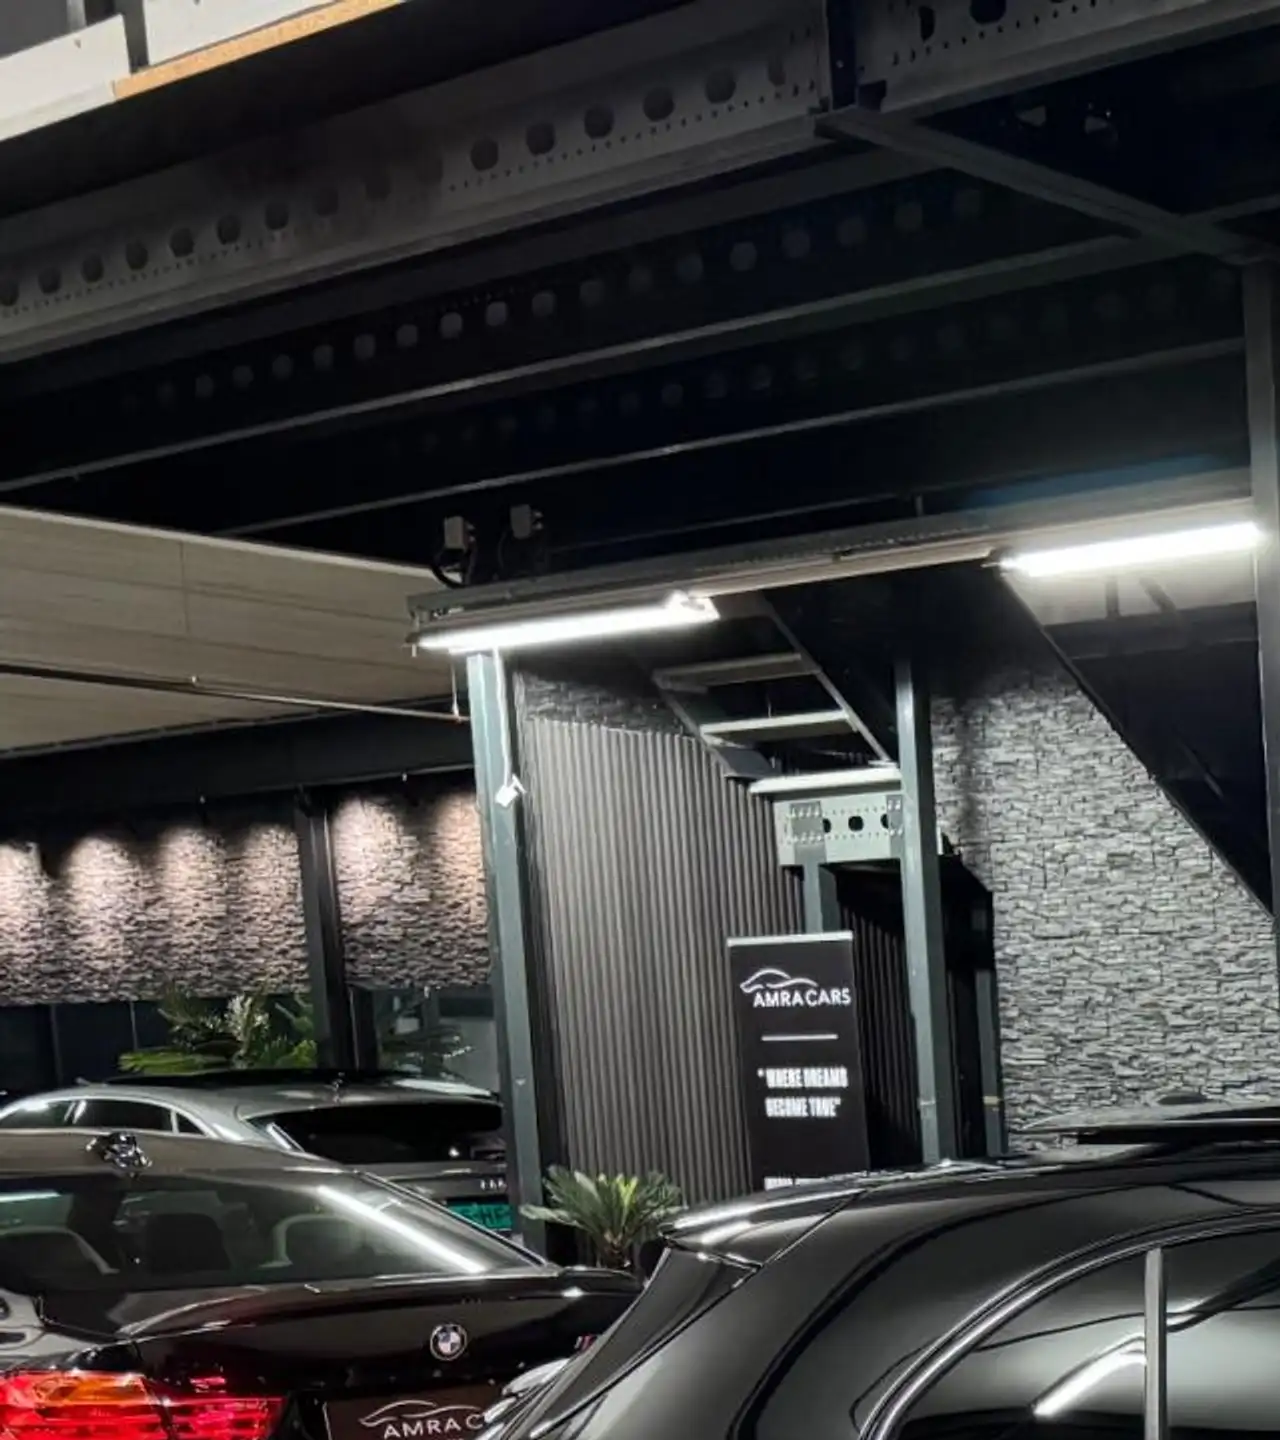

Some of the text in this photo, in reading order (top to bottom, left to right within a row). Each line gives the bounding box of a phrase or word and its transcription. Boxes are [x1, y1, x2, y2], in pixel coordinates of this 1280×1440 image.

[753, 987, 852, 1008] AMRA CARS
[384, 1417, 462, 1440] AMRA
